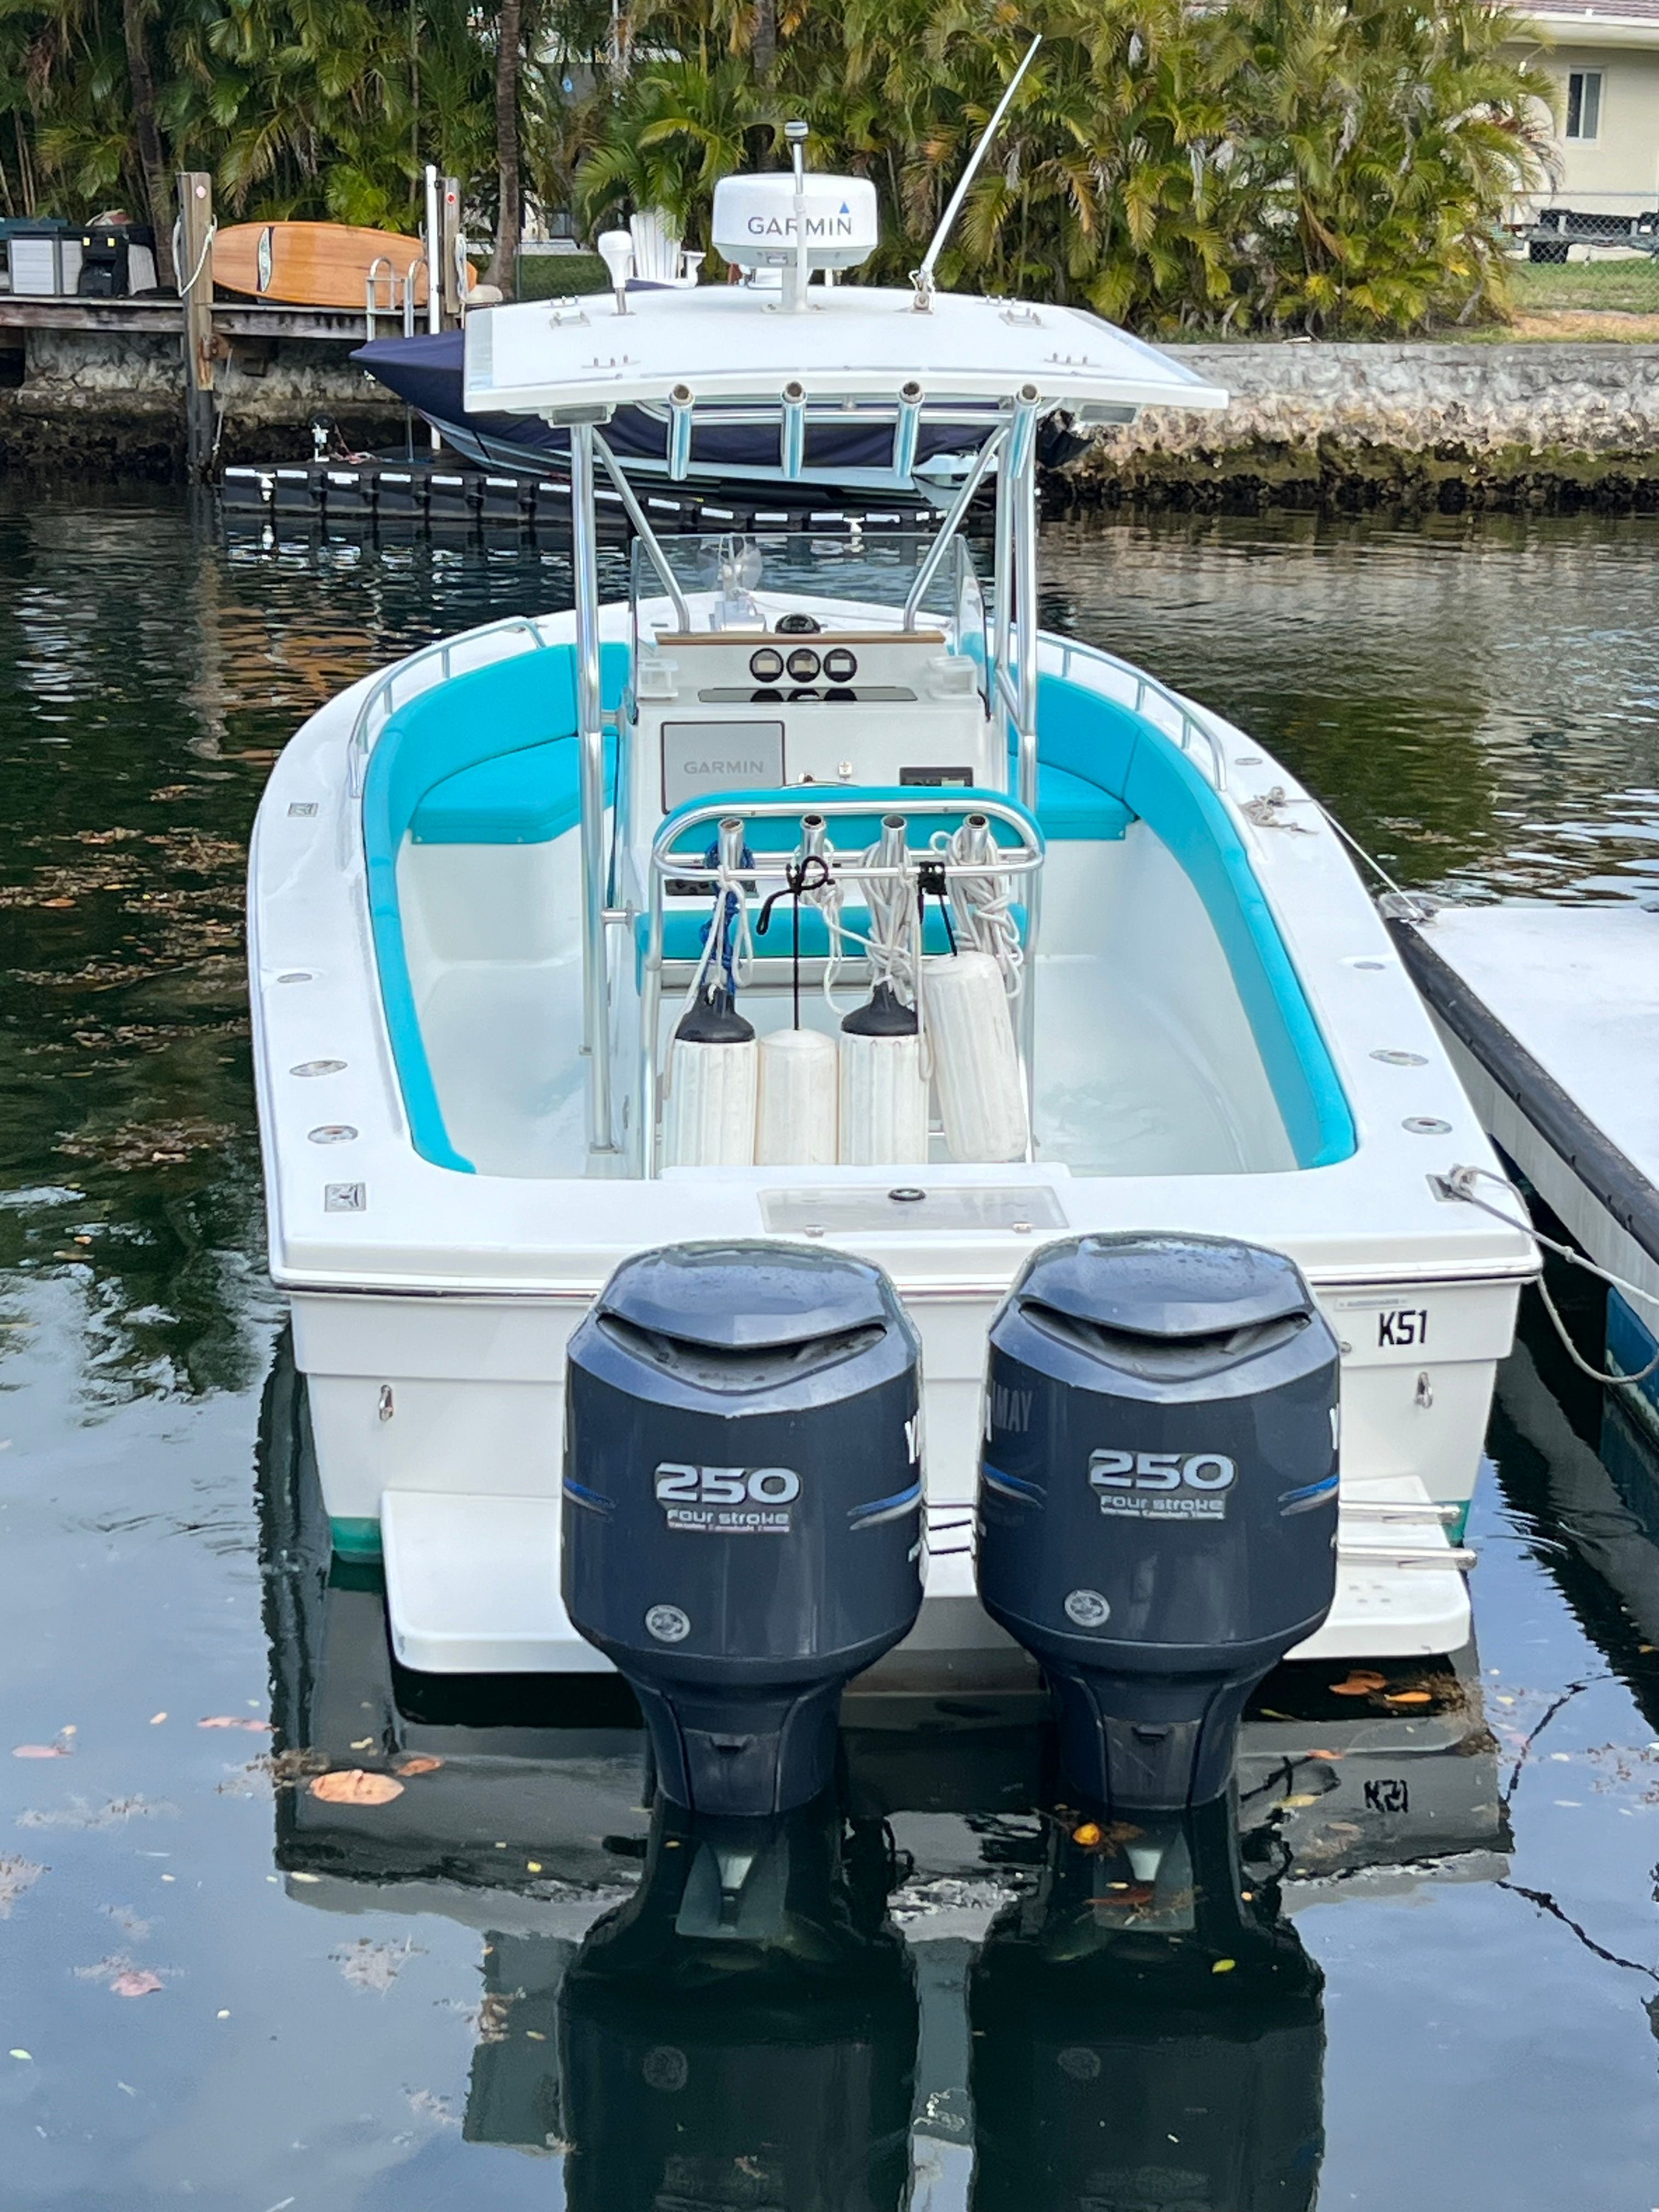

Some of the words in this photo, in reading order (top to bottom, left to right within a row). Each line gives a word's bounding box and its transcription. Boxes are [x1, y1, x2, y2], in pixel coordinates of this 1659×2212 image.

[748, 217, 852, 236] GARMIN
[684, 760, 764, 774] GARMIN
[1378, 1310, 1427, 1347] K51
[656, 1462, 800, 1504] 250
[1090, 1448, 1234, 1489] 250
